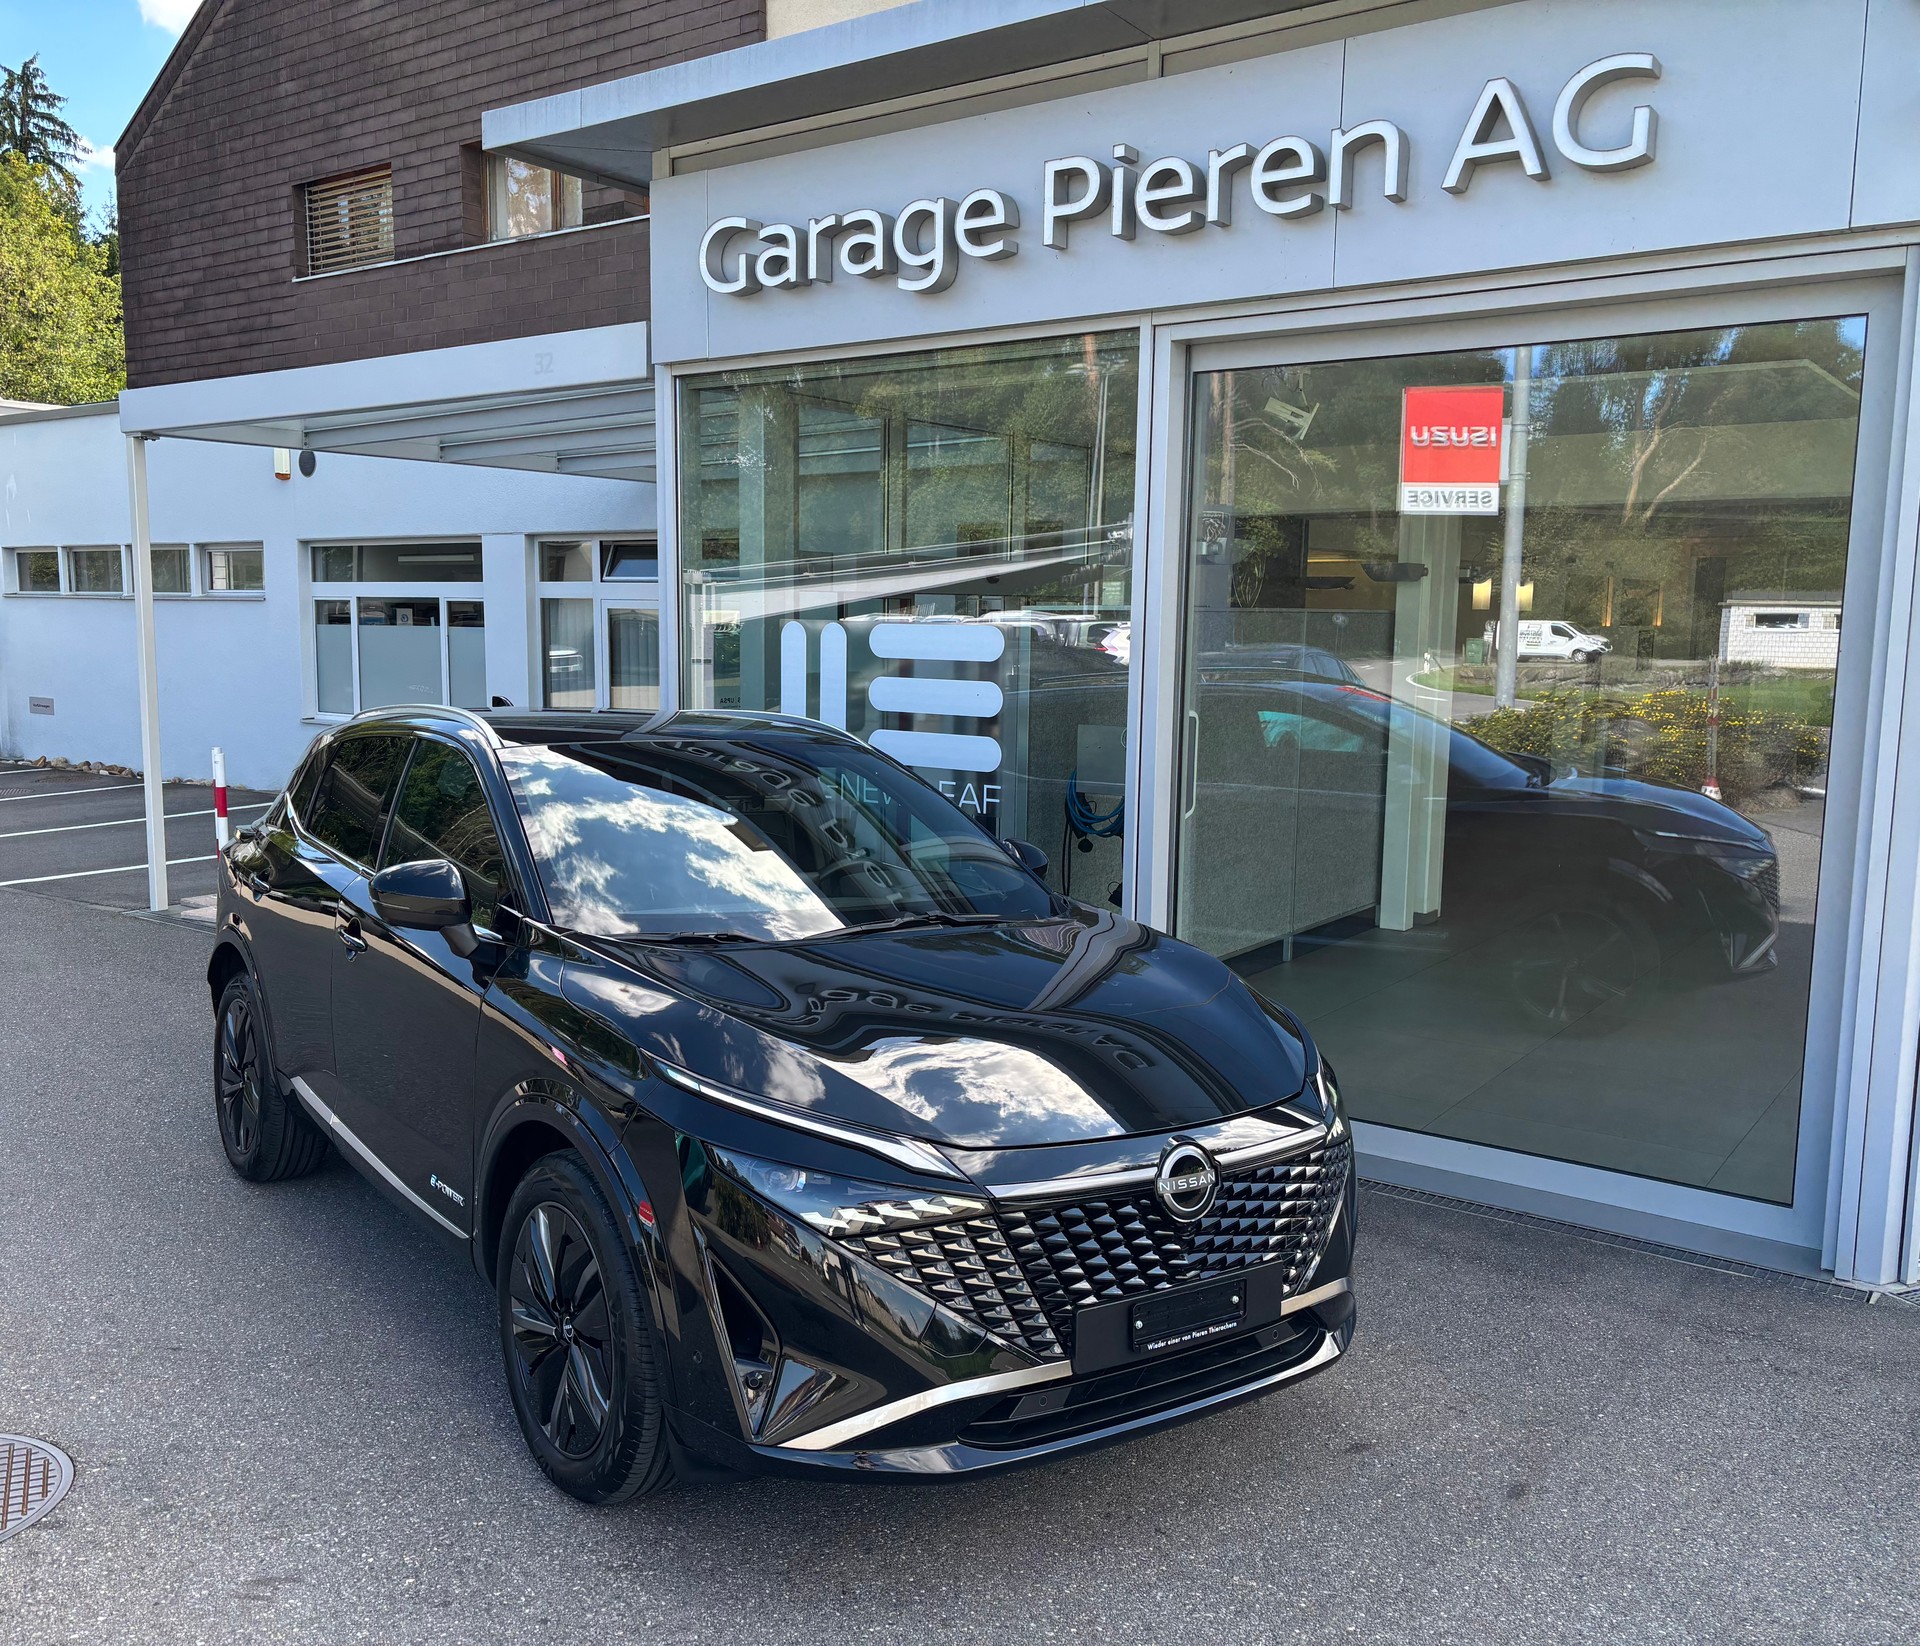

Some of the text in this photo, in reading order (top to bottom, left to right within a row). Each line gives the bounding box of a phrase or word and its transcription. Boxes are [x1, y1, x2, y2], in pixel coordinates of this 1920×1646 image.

[698, 52, 1662, 295] Garage Pieren AG
[534, 352, 554, 375] 32
[1159, 1171, 1215, 1192] NISSAN
[1147, 1321, 1237, 1351] Wieder einer von Pieren Thierachern
